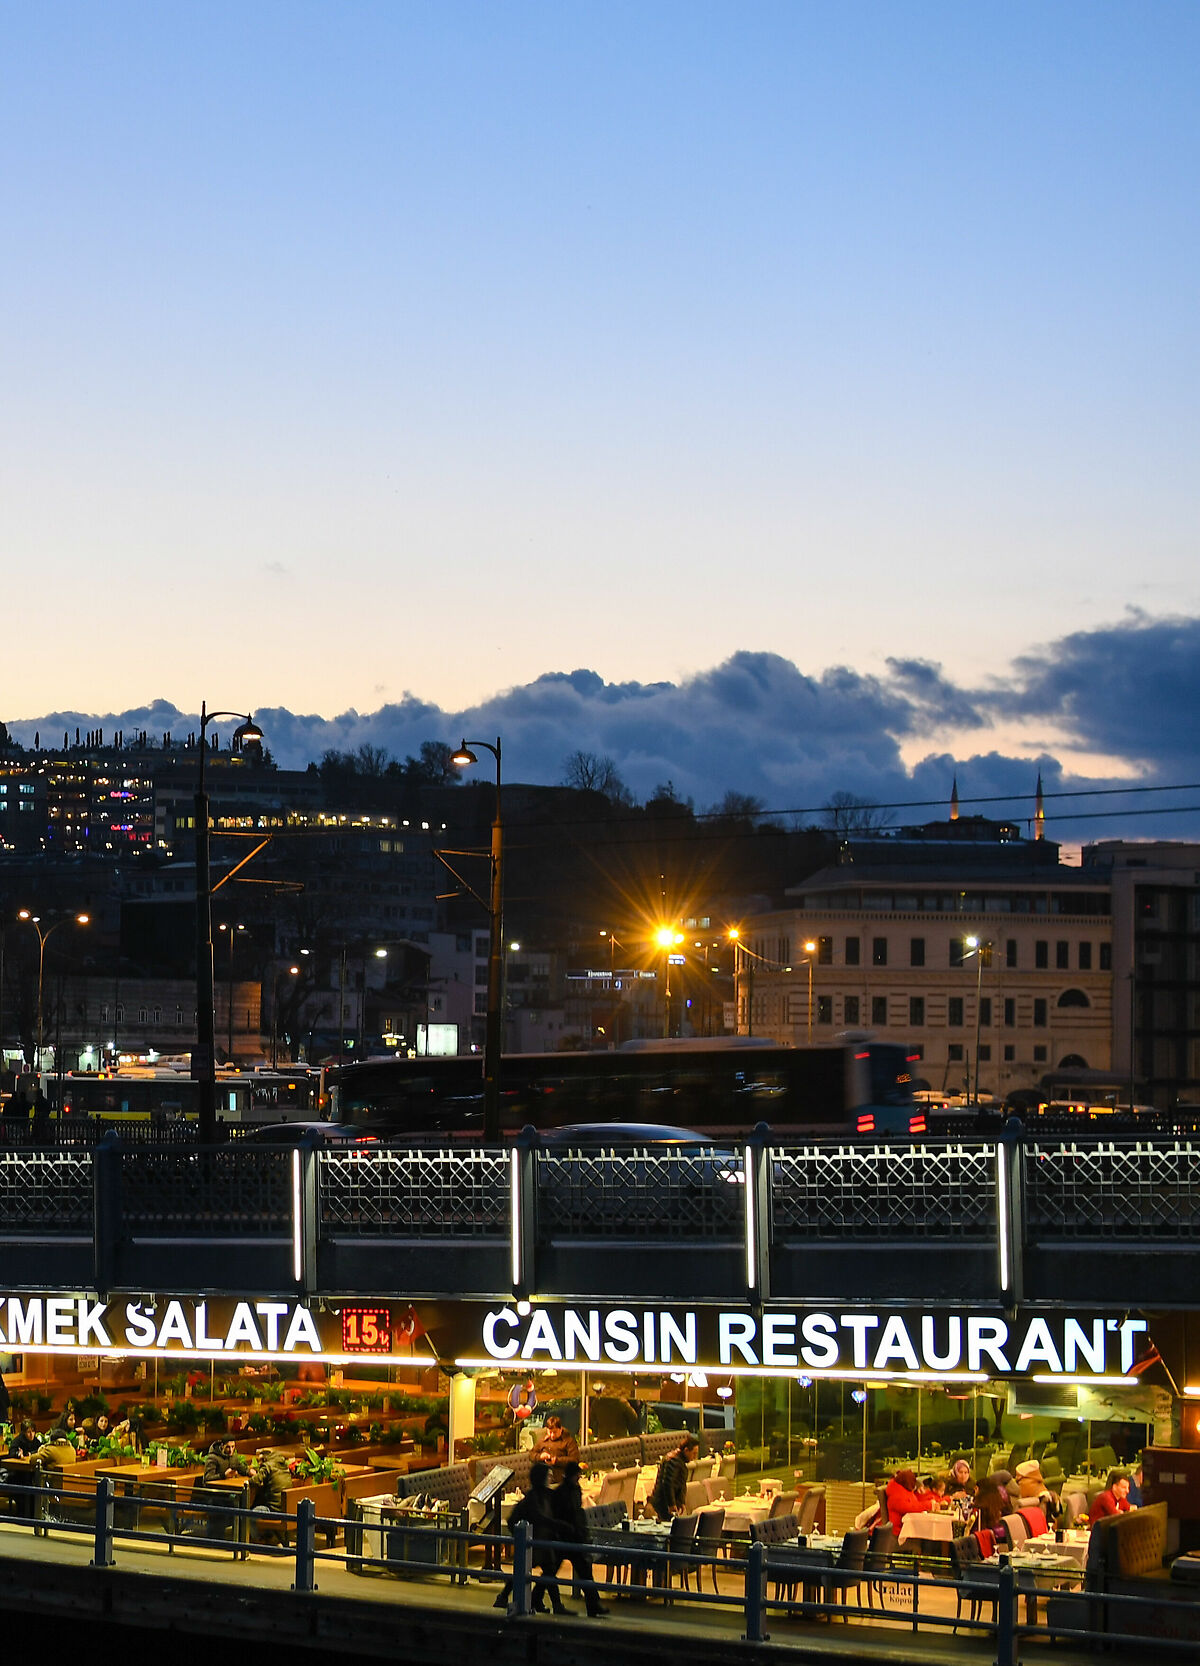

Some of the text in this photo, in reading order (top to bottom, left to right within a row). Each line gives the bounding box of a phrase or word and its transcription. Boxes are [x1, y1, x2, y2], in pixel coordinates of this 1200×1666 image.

[124, 1299, 323, 1353] SALATA
[482, 1308, 1147, 1373] CANSIN RESTAURANT
